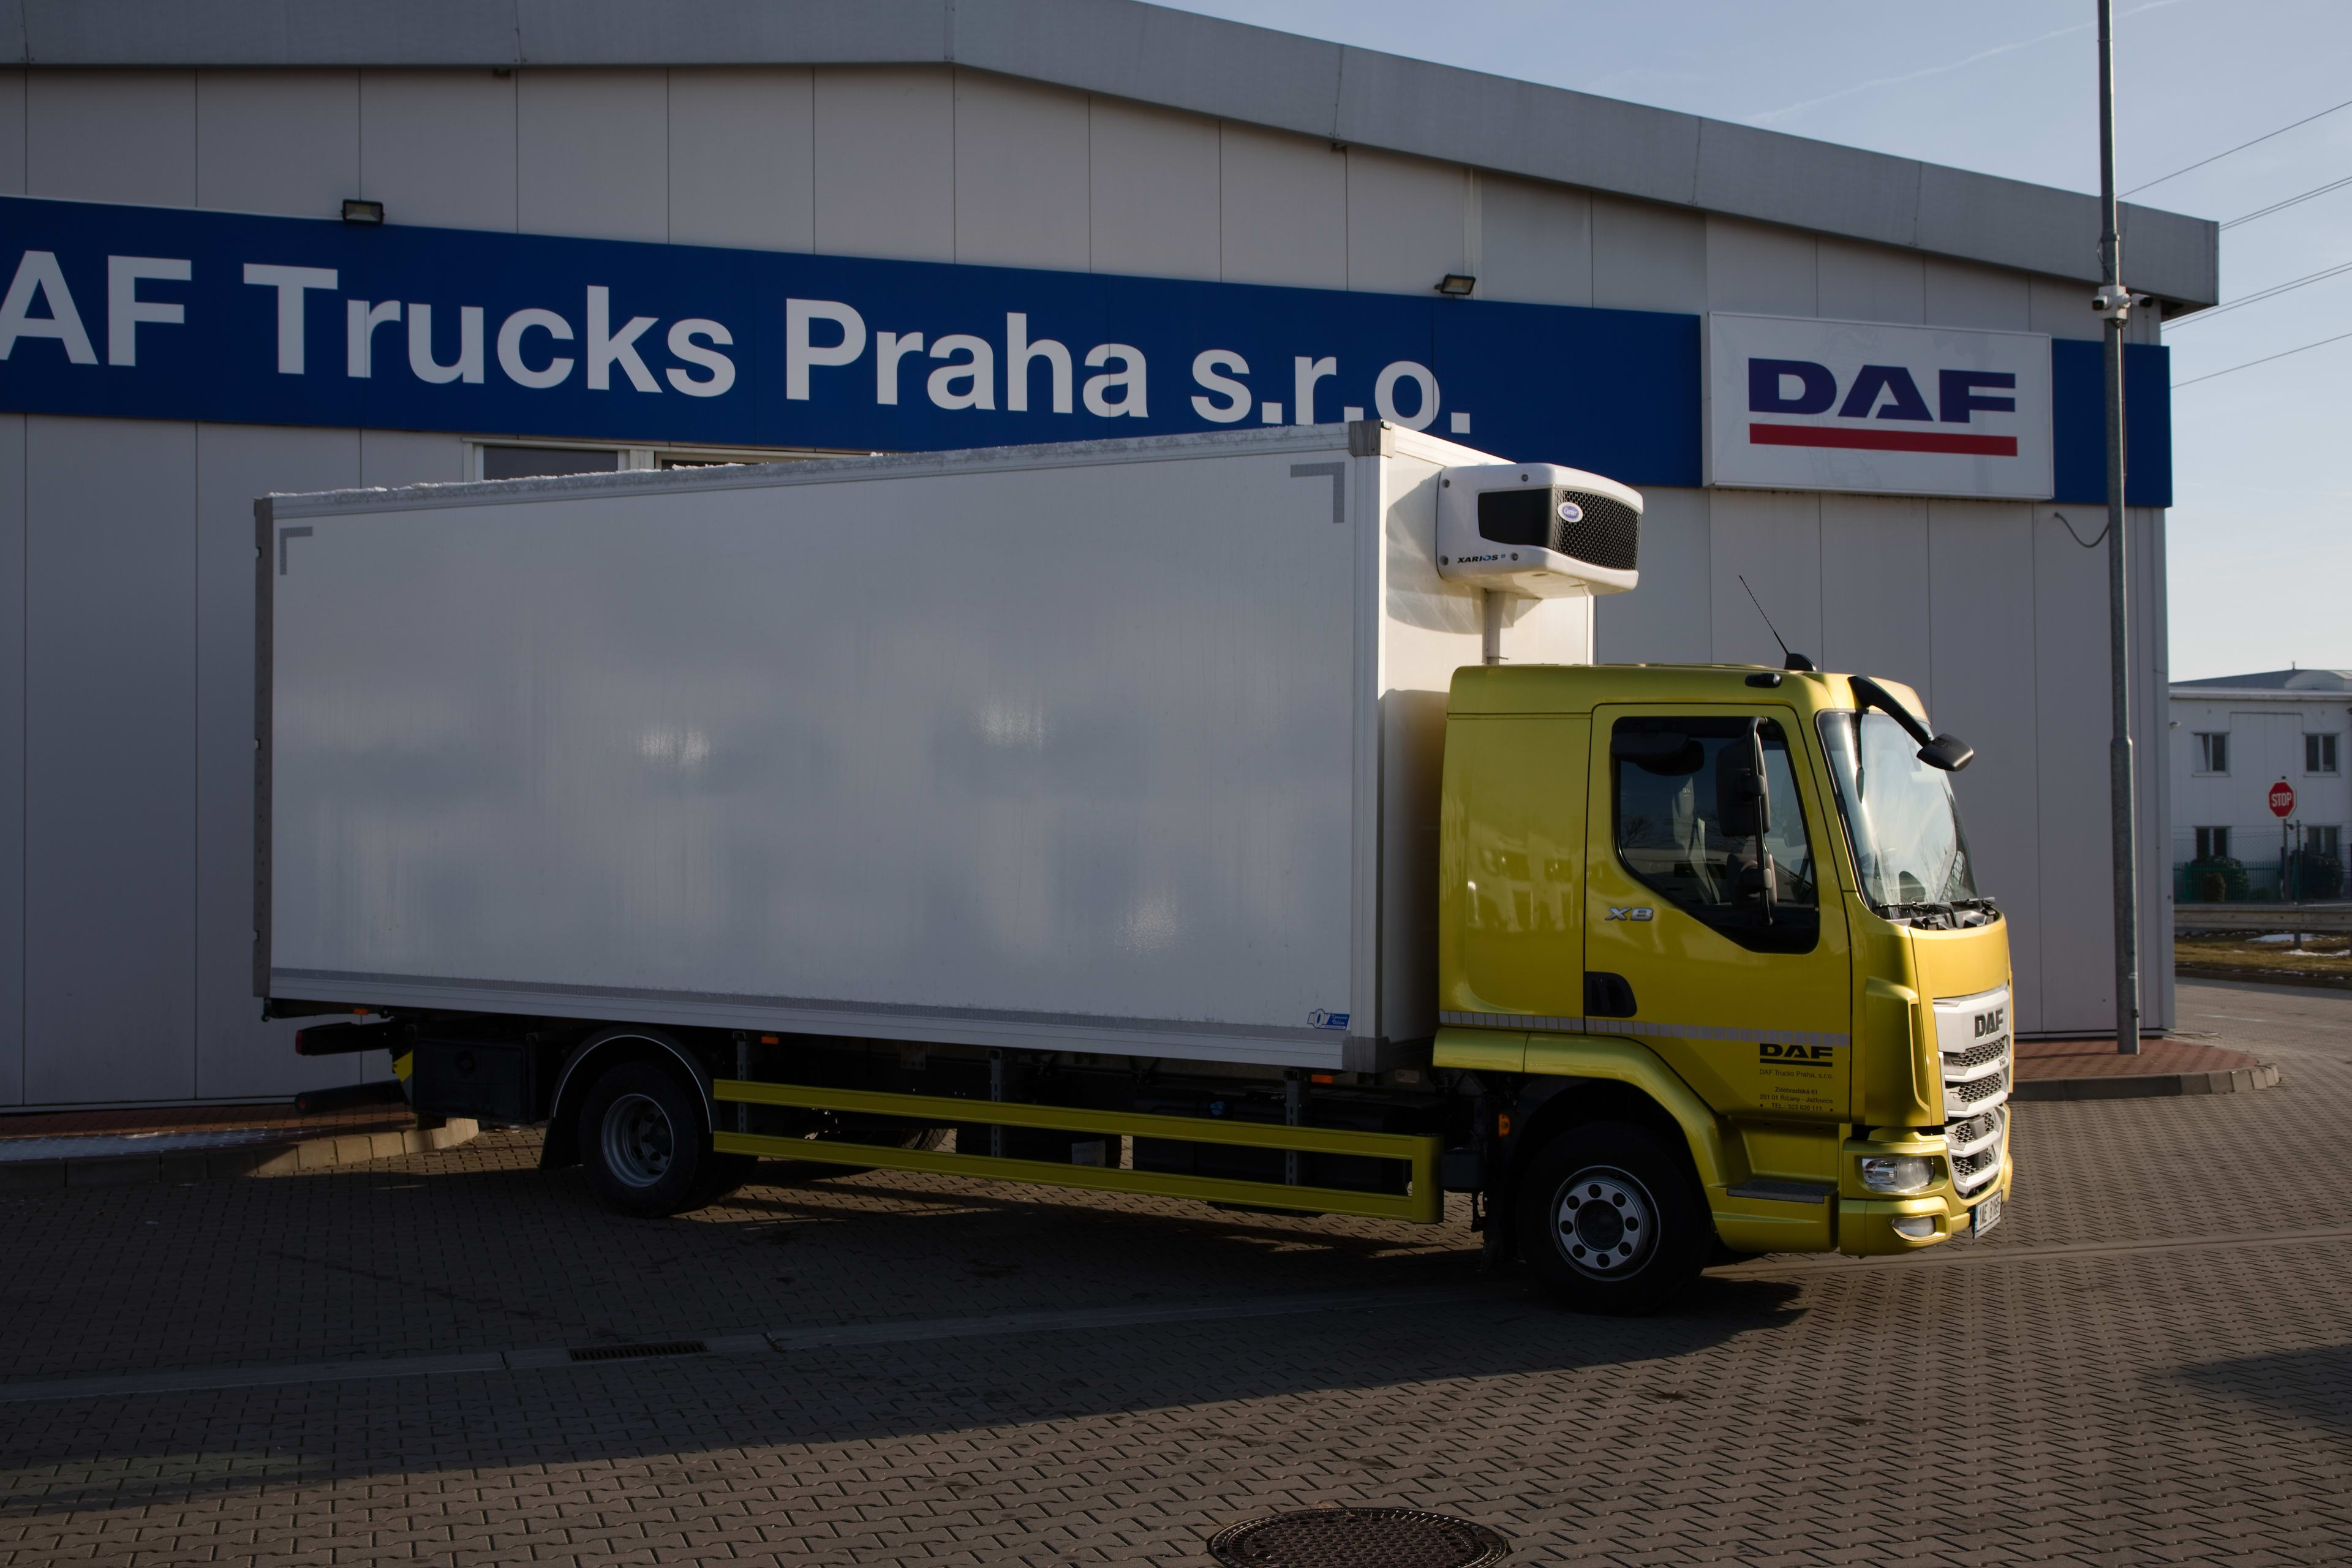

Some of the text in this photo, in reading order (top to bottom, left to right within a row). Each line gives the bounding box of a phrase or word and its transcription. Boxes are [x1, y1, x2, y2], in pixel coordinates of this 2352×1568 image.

[244, 264, 736, 398] Trucks
[786, 298, 1149, 418] Praha
[1191, 350, 1471, 434] s.r.o.
[1749, 358, 2016, 423] DAF
[1564, 507, 1578, 516] Carrier
[1457, 554, 1499, 564] XARIOS
[2272, 792, 2292, 807] STOP
[1604, 907, 1654, 922] XB
[1974, 1008, 2003, 1038] DAF
[1760, 1043, 1833, 1059] DAF
